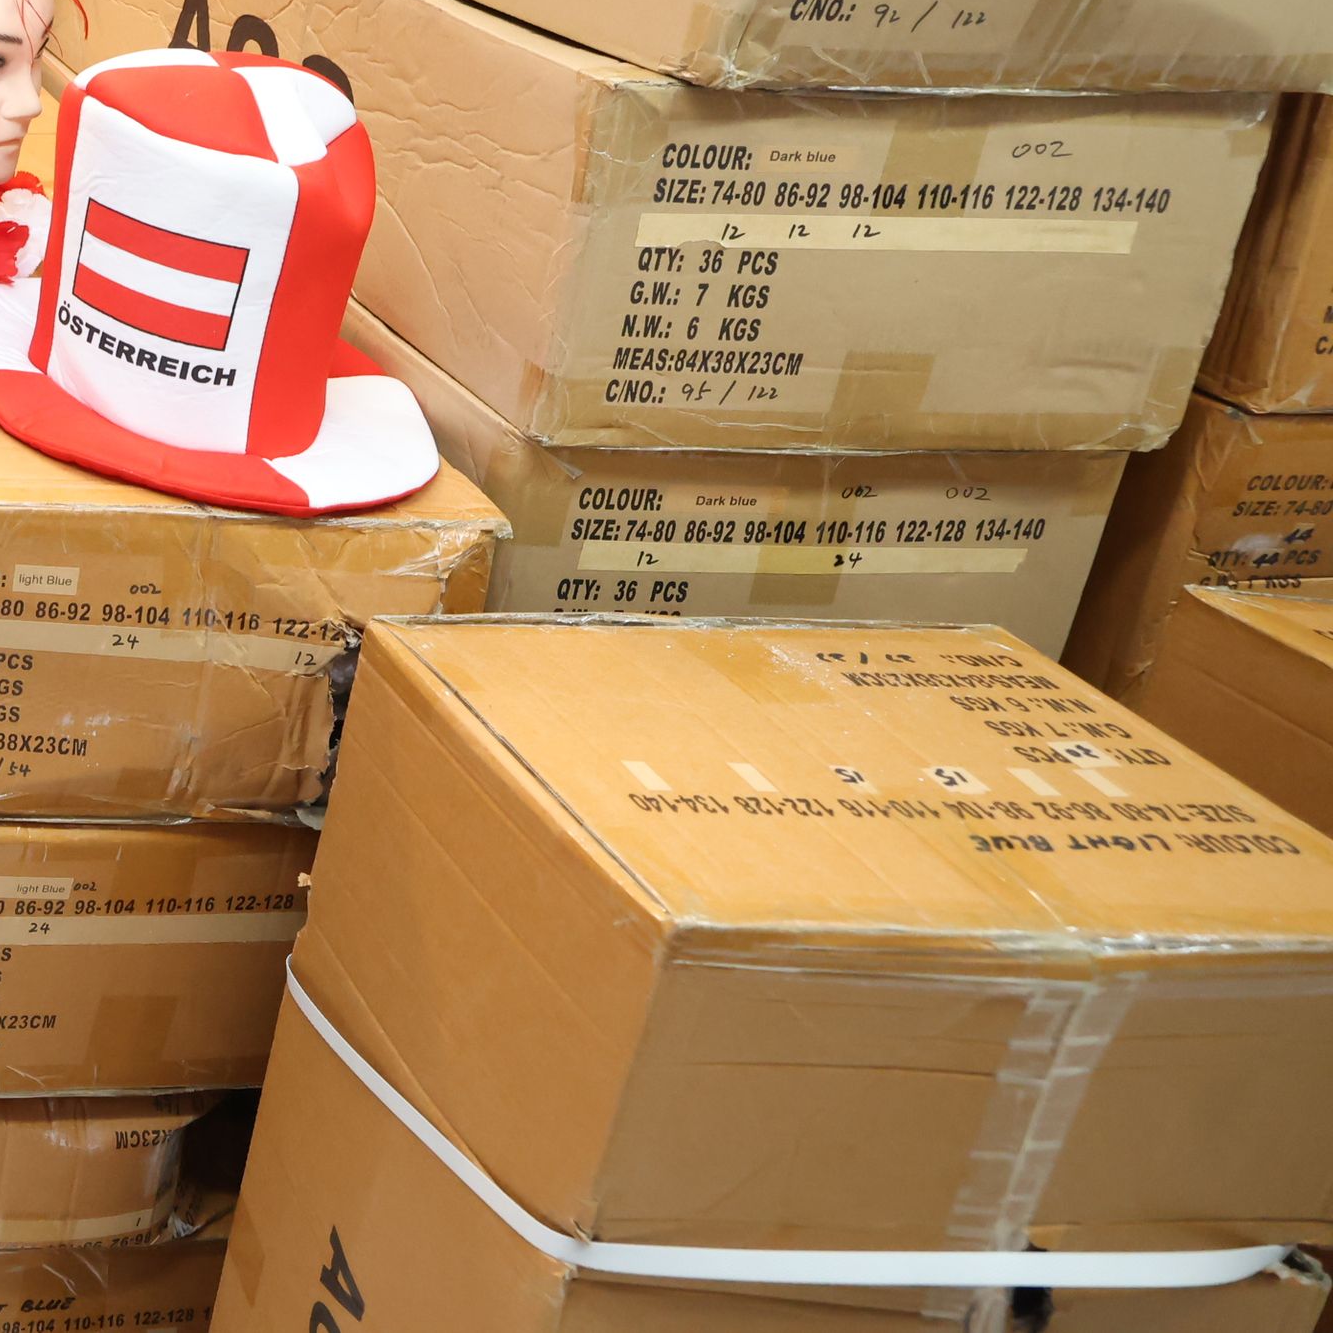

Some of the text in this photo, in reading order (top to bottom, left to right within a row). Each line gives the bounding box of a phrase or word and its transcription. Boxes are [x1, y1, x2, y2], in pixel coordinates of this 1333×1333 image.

[663, 143, 836, 170] COLOUR: Dark blue
[775, 182, 830, 207] 86-92
[839, 184, 907, 209] 98-104
[918, 184, 994, 209] 110-116
[1006, 185, 1082, 211] 122-128
[1094, 187, 1170, 213] 134-140
[789, 224, 810, 239] 12
[58, 300, 236, 387] ÖSTERREICH
[19, 574, 43, 586] light
[47, 575, 72, 586] Blue
[36, 601, 90, 621] 86-92
[102, 604, 169, 625] 98-104
[183, 608, 260, 630] 110-116
[272, 617, 344, 641] 122-12
[112, 633, 317, 666] 24 12
[15, 893, 297, 915] 86-92 98-104 110-116 122-128
[29, 923, 50, 935] 24
